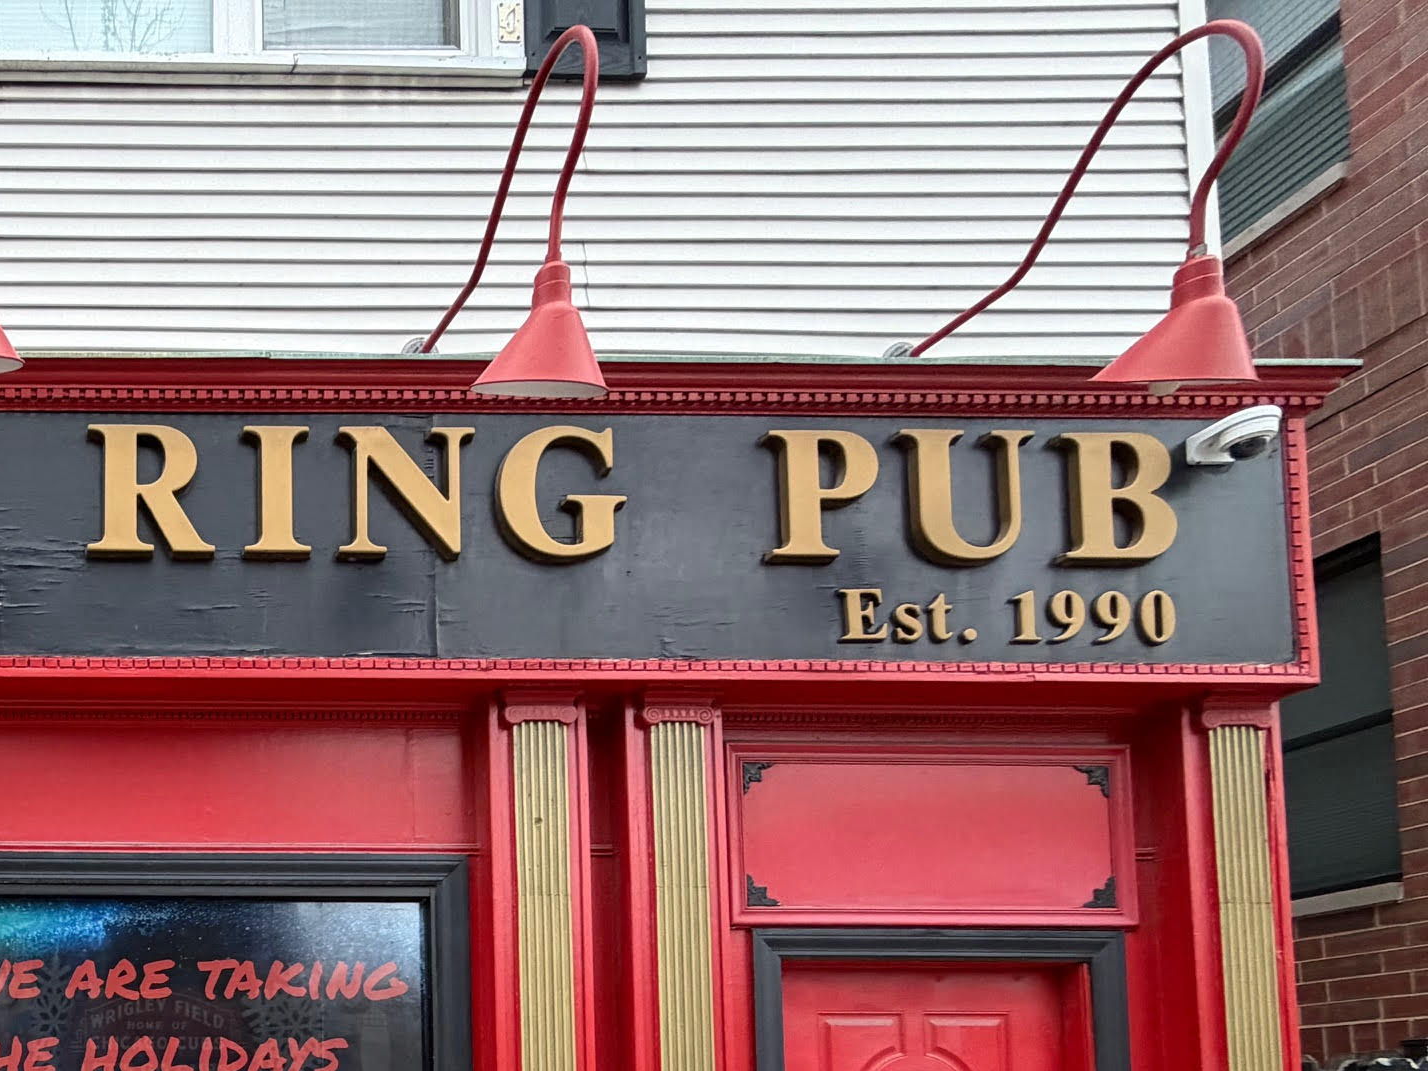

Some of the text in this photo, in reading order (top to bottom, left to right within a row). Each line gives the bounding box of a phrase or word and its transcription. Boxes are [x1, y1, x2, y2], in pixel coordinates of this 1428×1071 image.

[86, 423, 628, 563] RING
[759, 428, 1179, 568] PUB
[836, 587, 1177, 647] Est. 1990
[65, 958, 175, 1000] ARE
[197, 958, 409, 1001] TAKING
[173, 999, 226, 1030] FIELD
